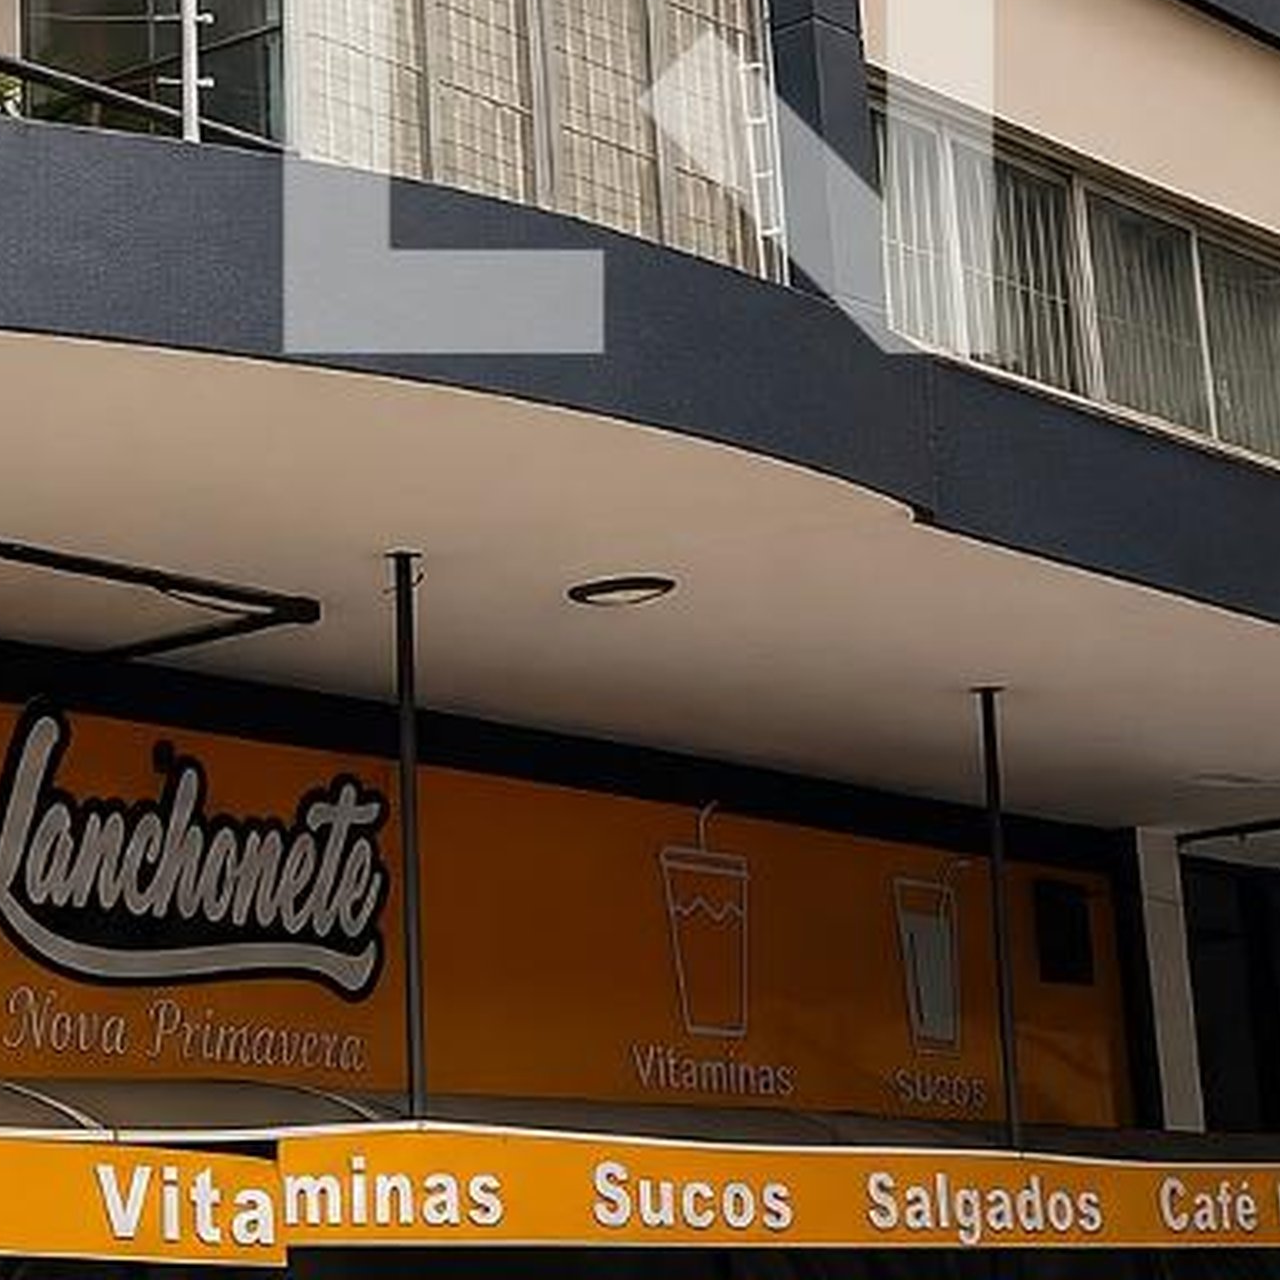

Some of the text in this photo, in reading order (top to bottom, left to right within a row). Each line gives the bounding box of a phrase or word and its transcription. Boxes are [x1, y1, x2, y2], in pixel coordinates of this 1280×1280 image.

[3, 985, 365, 1071] Nova Primavera
[633, 1044, 797, 1096] Vitaminas
[96, 1156, 503, 1245] Vitaminas
[593, 1161, 794, 1229] Sucos
[866, 1171, 1104, 1244] Salgados
[1160, 1176, 1258, 1232] Café
